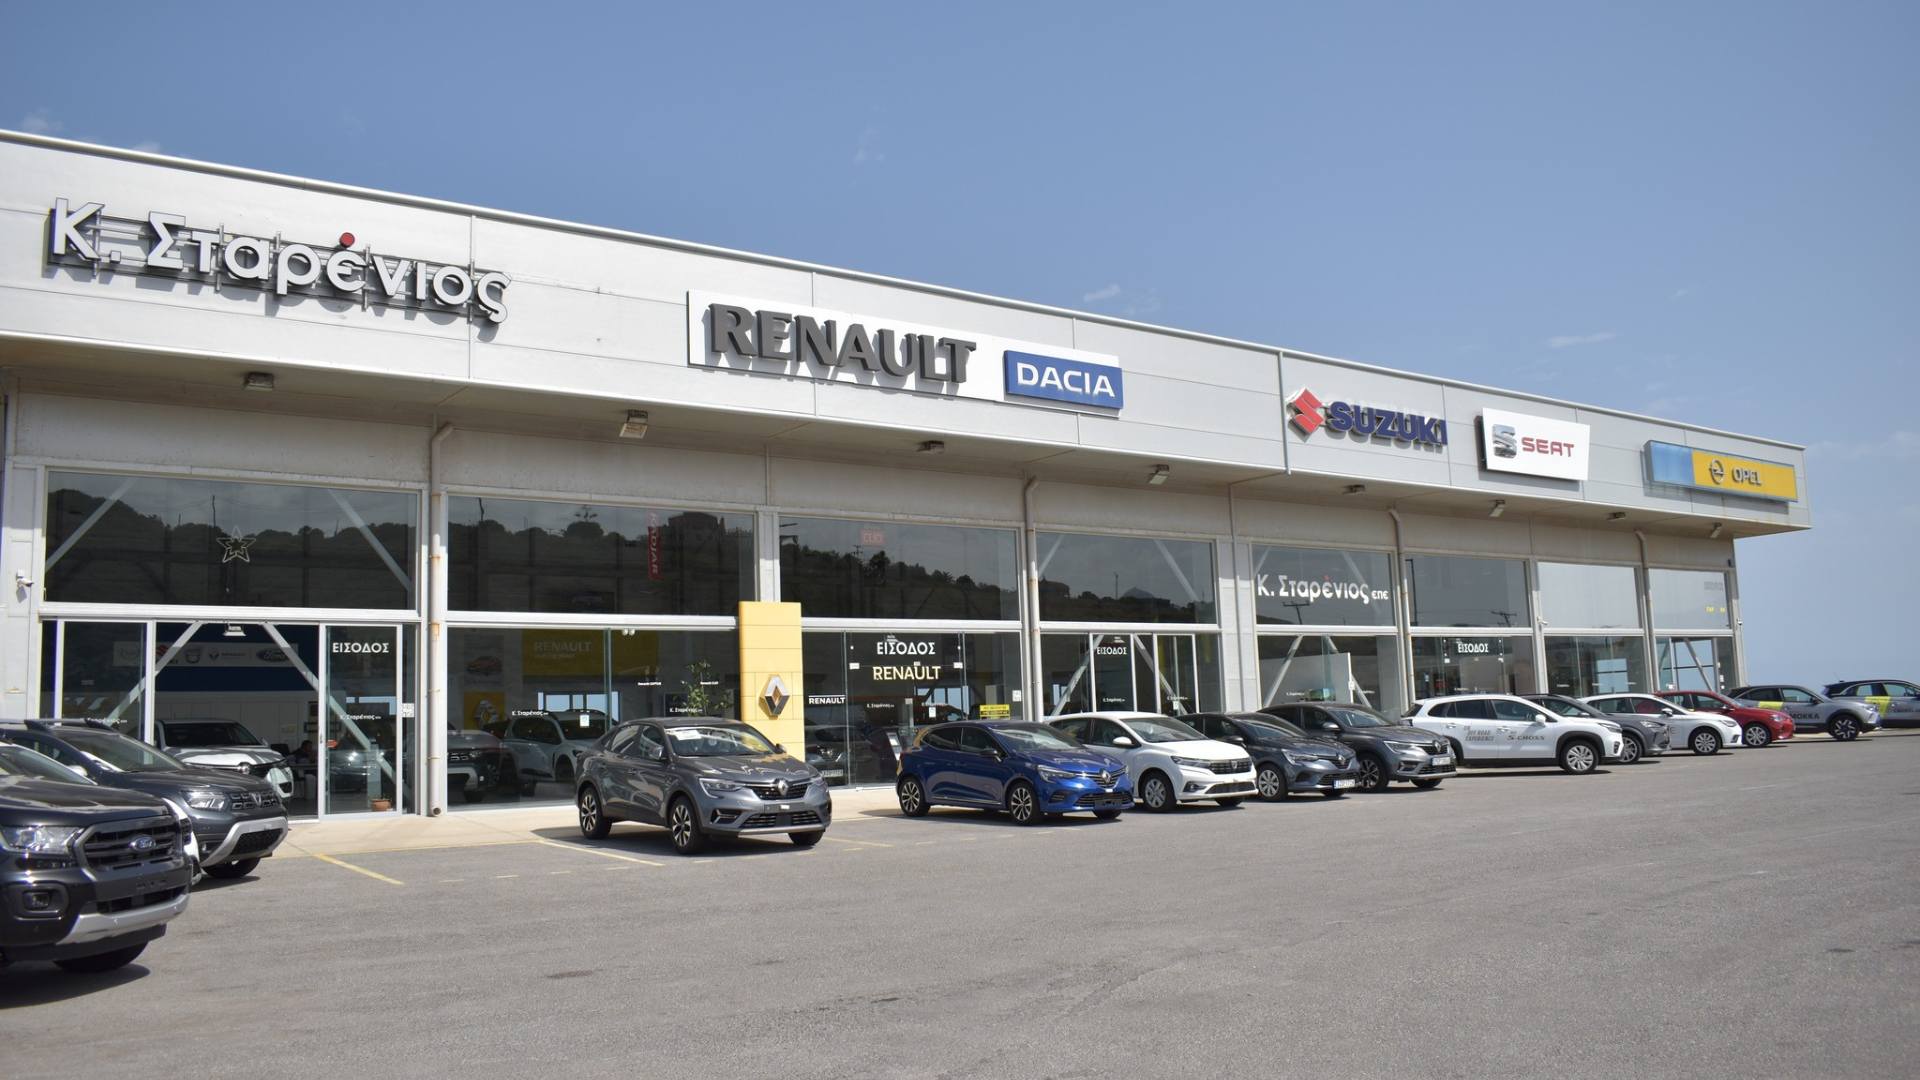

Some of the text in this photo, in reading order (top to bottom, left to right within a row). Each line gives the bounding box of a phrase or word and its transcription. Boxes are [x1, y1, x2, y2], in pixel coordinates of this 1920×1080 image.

[51, 197, 512, 325] Κ. Σταρένιος
[708, 302, 977, 384] RENAULT
[1015, 361, 1116, 399] DACIA
[1329, 401, 1448, 446] SUZUKI
[1521, 437, 1575, 459] SEAT
[1731, 467, 1763, 487] OPEL
[1256, 573, 1275, 597] Κ.
[1278, 574, 1370, 605] Σταρένιος
[332, 642, 390, 654] ΕΙΣΟΔΟΣ
[876, 641, 936, 655] ΕΙΣΟΔΟΣ
[1096, 646, 1128, 655] ΕΙΣΟΔΟΣ
[1457, 643, 1489, 653] ΕΙΣΟΔΟΣ
[873, 665, 942, 681] RENAULT
[808, 697, 846, 705] RENAULT
